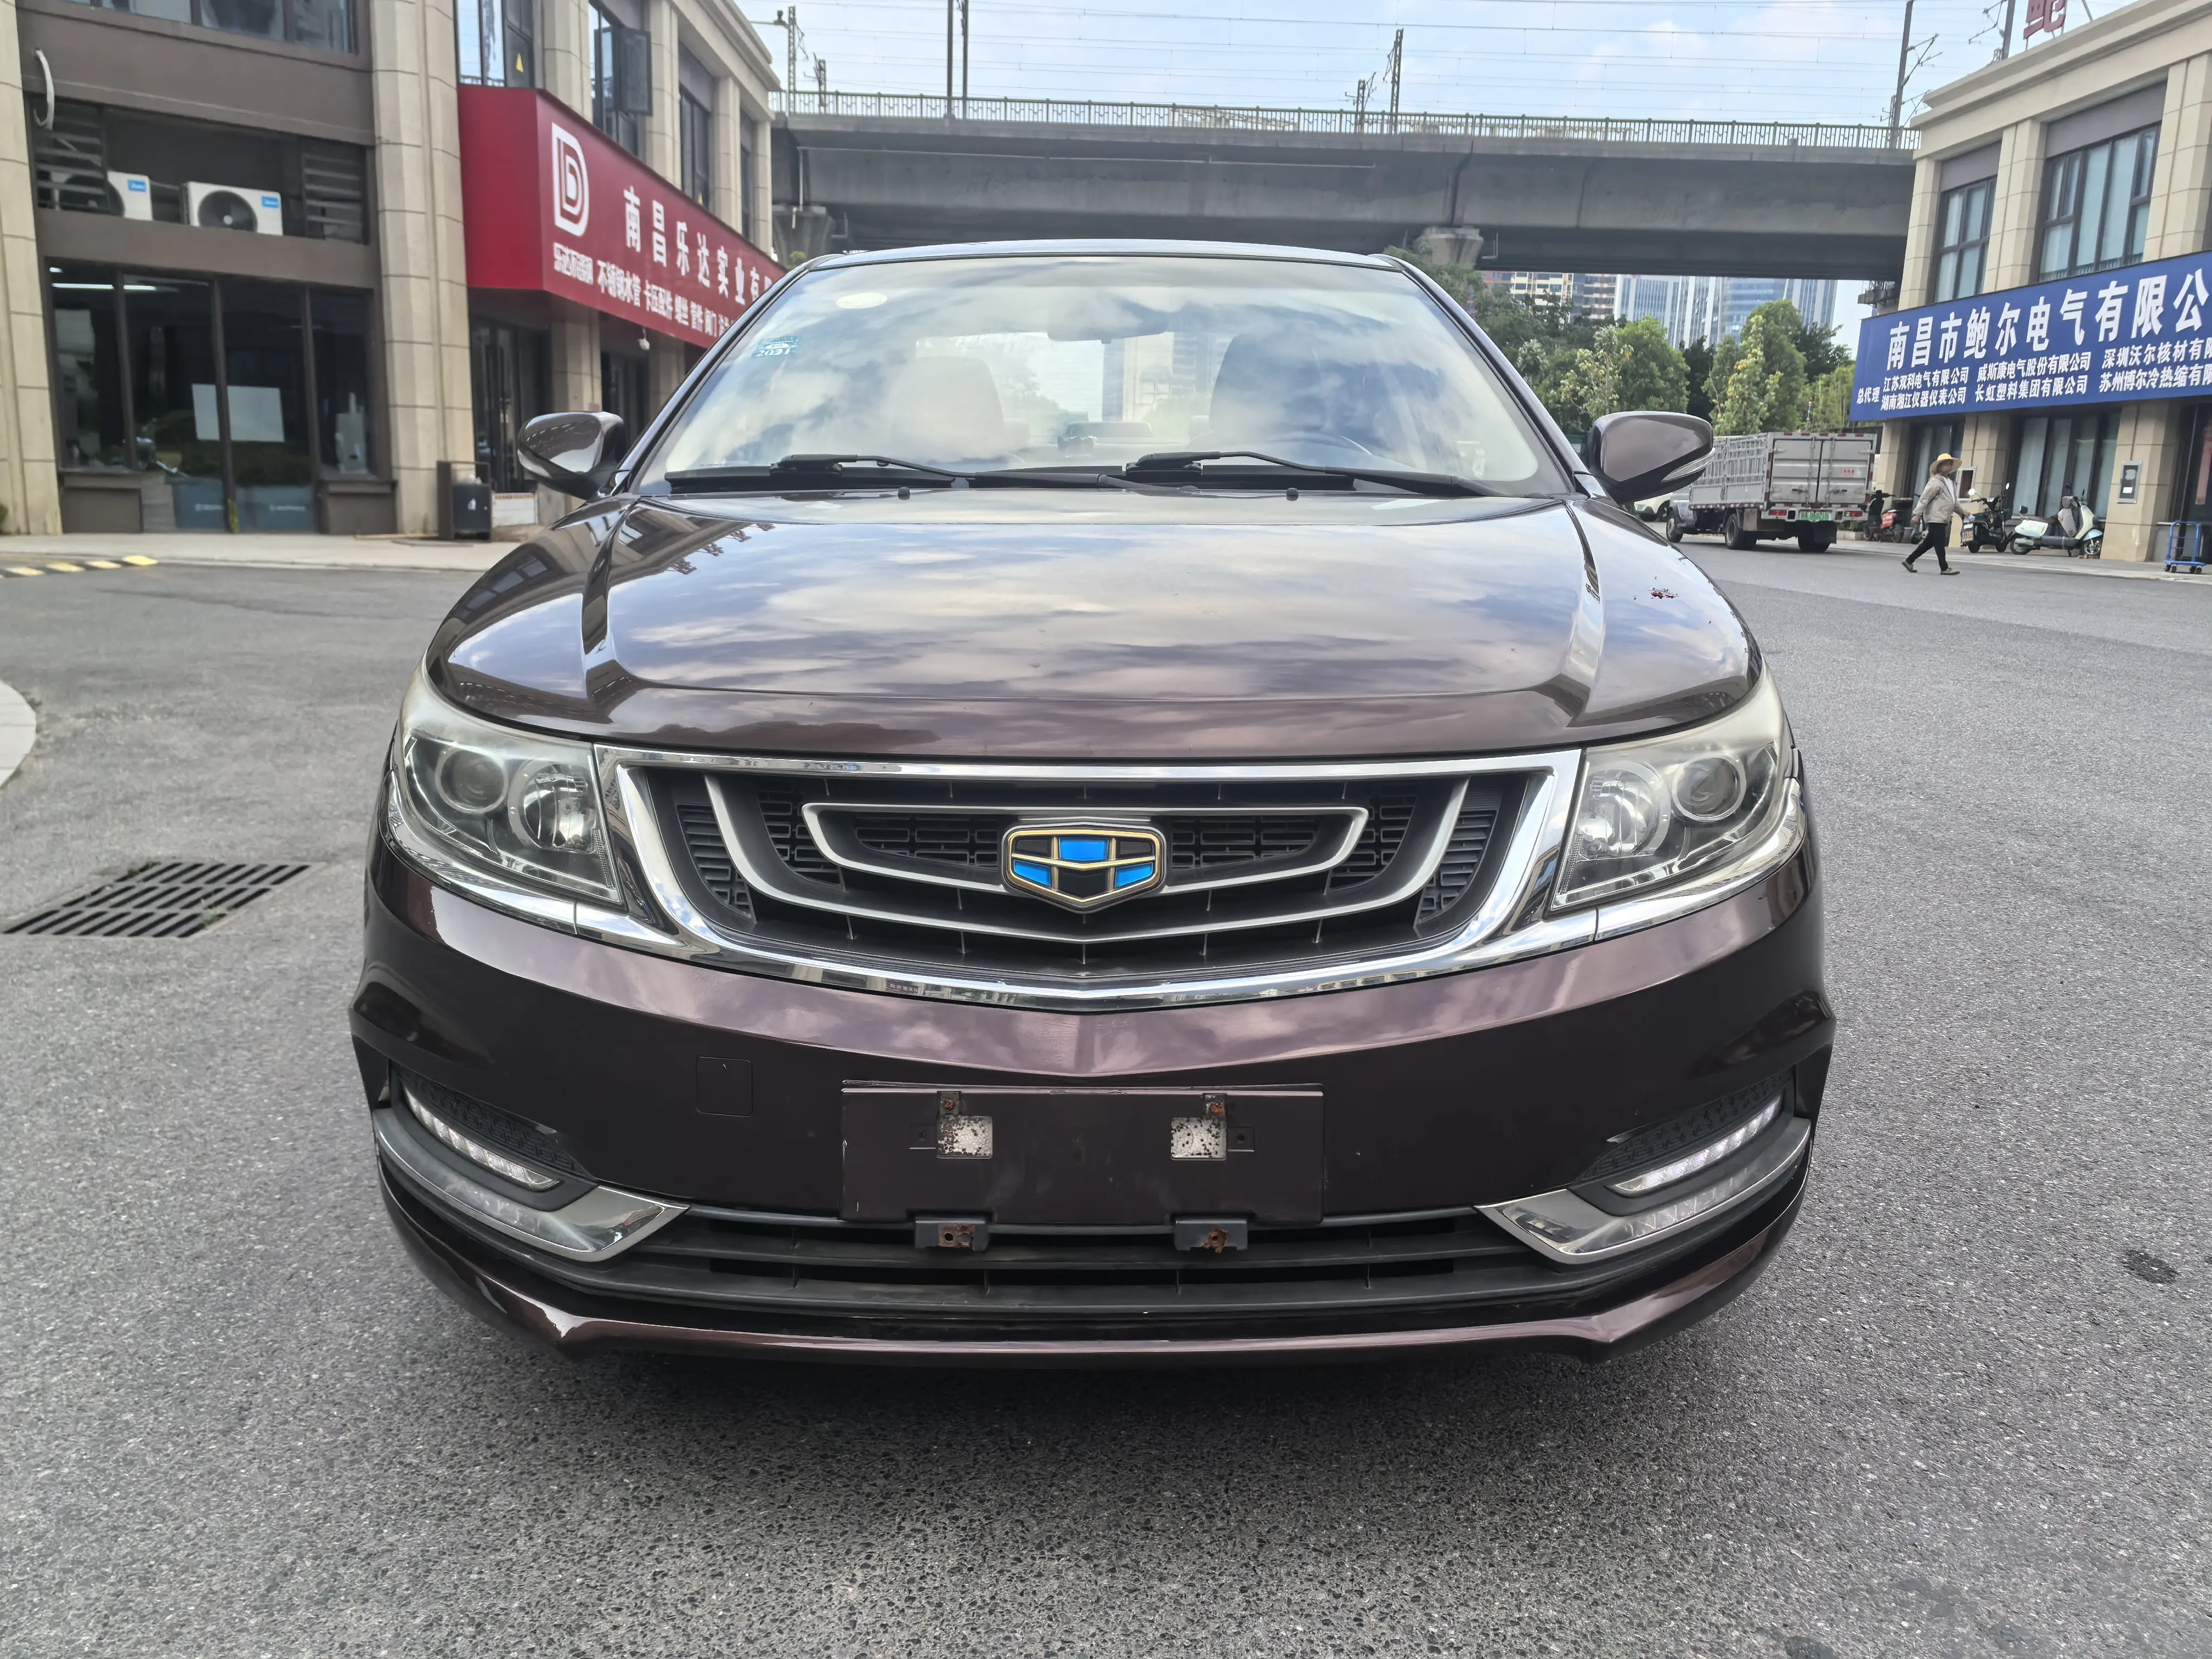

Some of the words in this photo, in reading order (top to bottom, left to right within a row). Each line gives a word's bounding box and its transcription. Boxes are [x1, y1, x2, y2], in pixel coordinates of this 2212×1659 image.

[1887, 268, 2209, 370] 南昌市鲍尔电气有限公
[754, 348, 790, 356] 2021
[1883, 367, 1969, 392] 江苏双科电气有限公司
[1977, 351, 2092, 382] 威斯康电气股份有限公司
[2102, 337, 2212, 369] 深圳沃尔核材有限
[1857, 387, 1880, 404] 总代理
[1880, 387, 1967, 411] 湖南湘江仪器仪表公司
[1975, 375, 2088, 402] 长虹塑料集团有限公司
